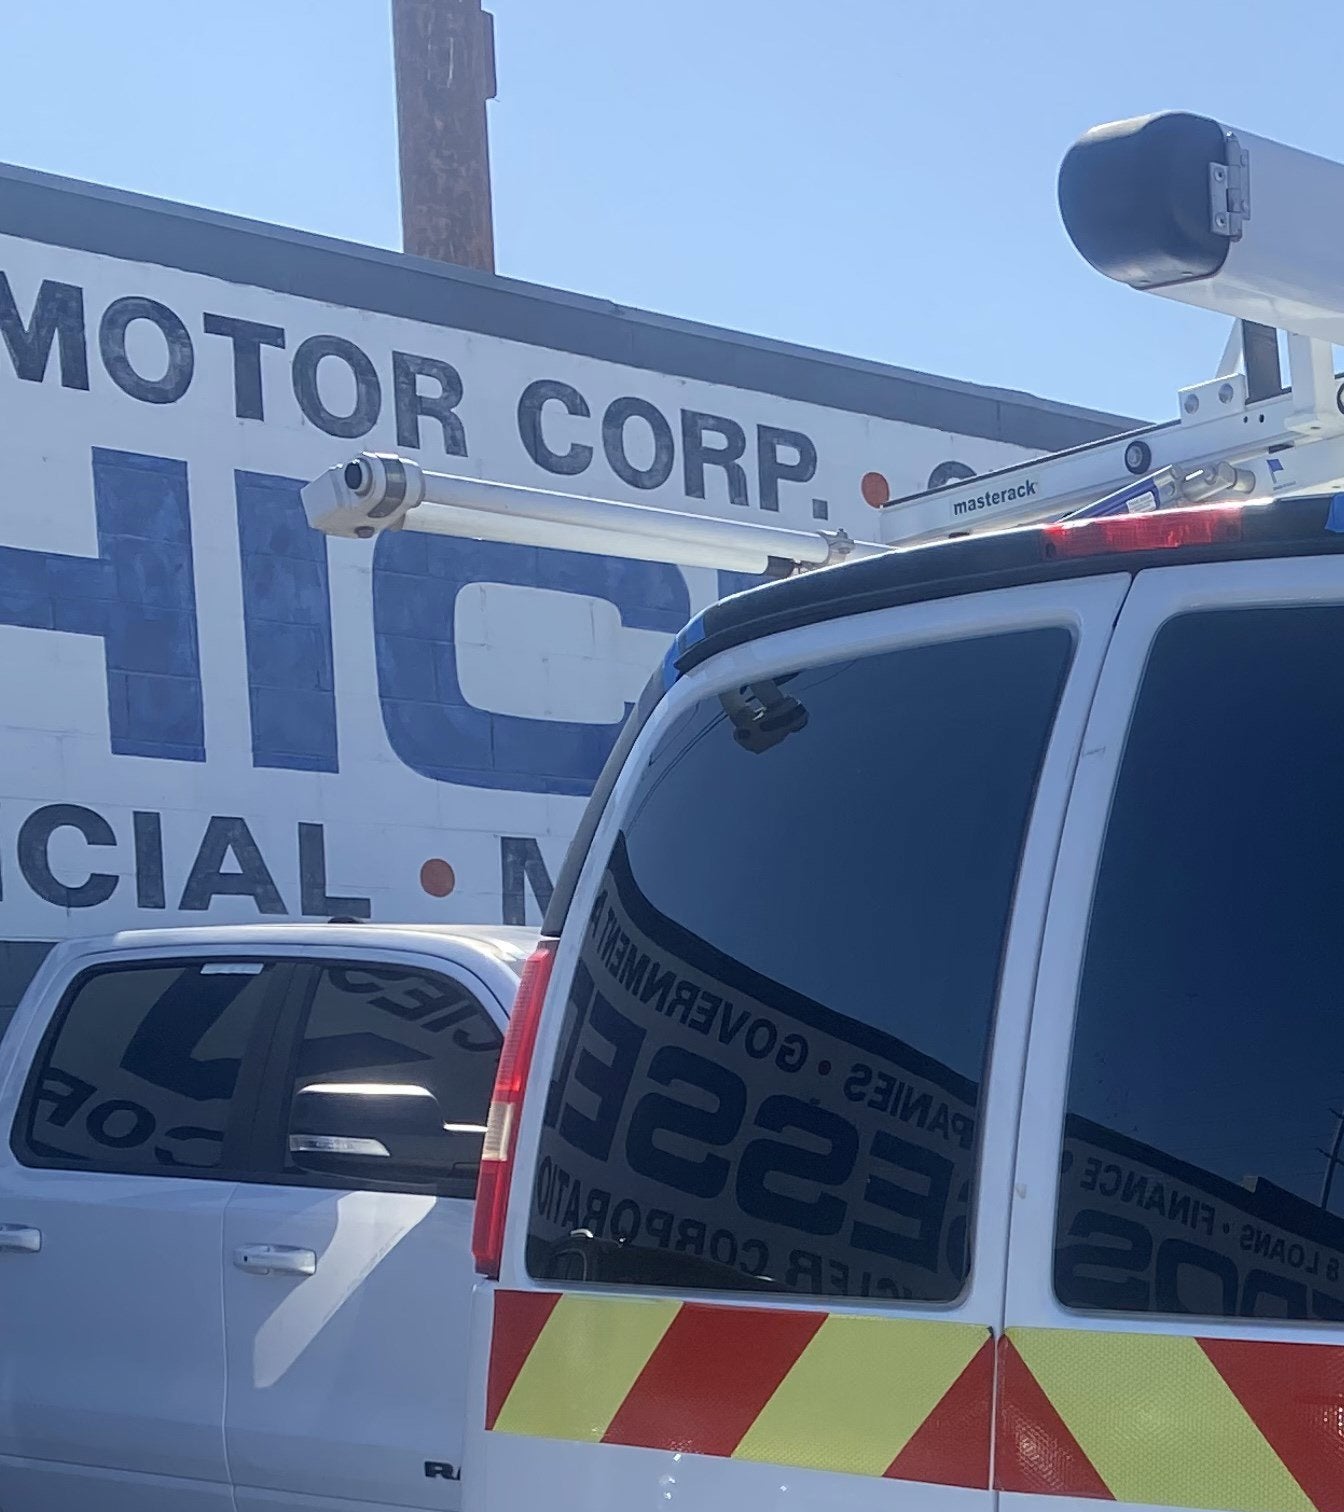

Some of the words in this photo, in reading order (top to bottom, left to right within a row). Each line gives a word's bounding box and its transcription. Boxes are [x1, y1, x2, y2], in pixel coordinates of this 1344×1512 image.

[0, 270, 467, 458] MOTOR
[517, 379, 830, 521] CORP.
[952, 480, 1037, 516] masterack
[0, 446, 770, 798] HIC
[0, 803, 372, 919] CIAL
[424, 1460, 462, 1482] R
